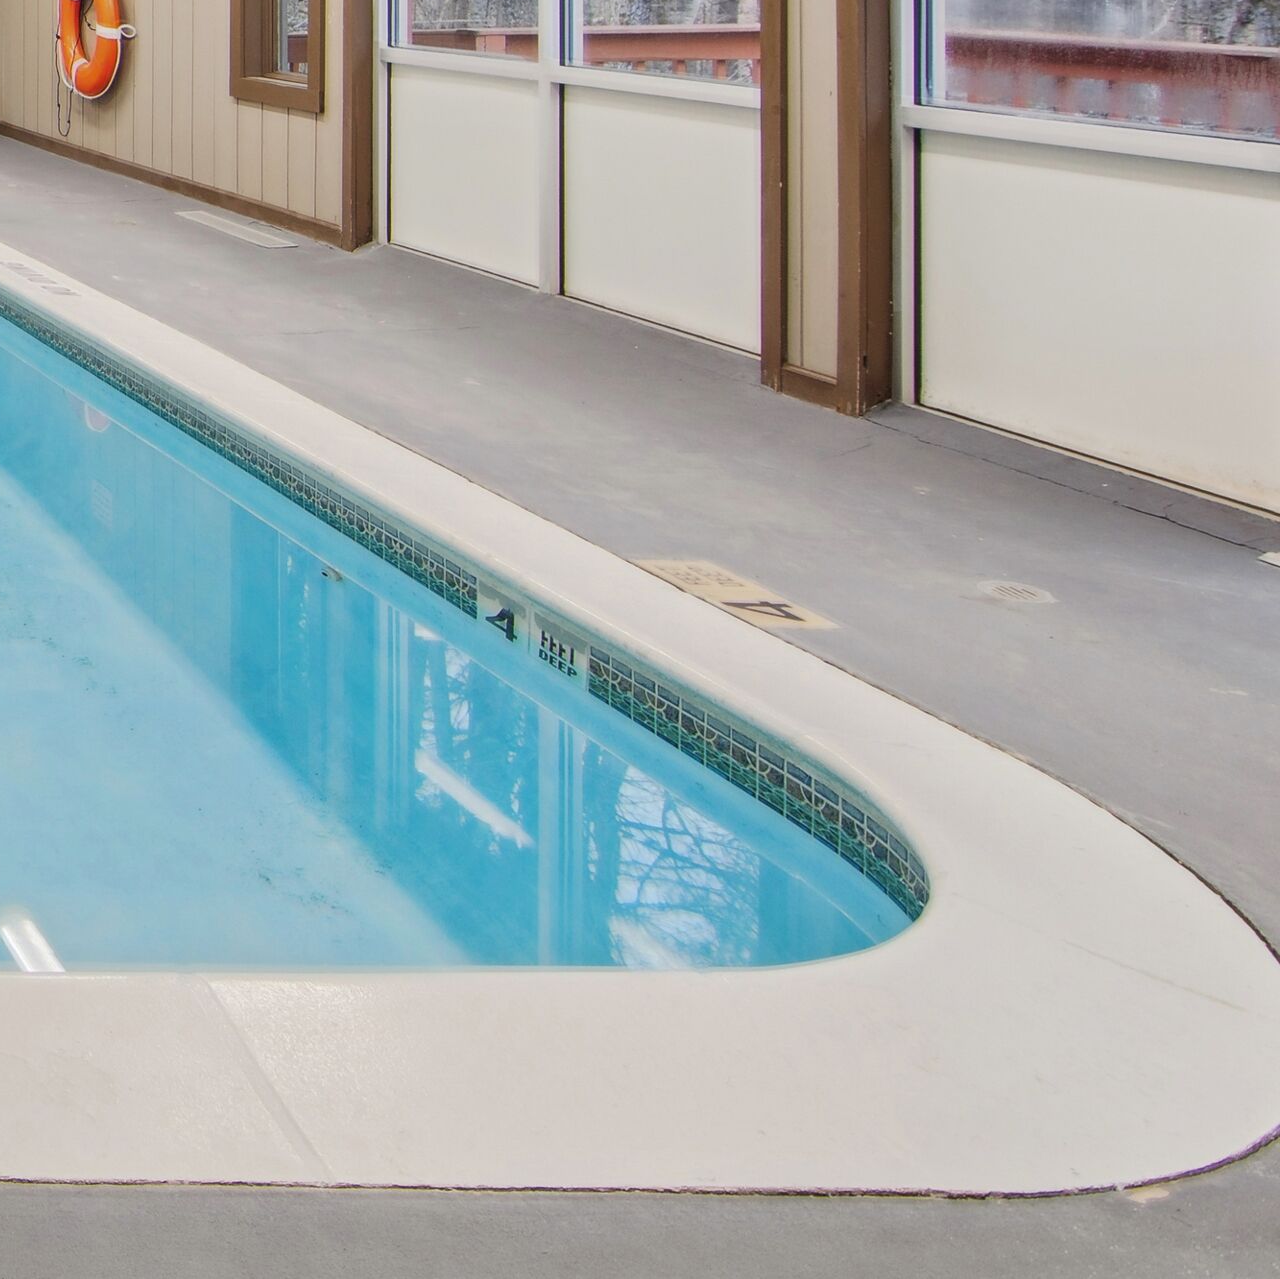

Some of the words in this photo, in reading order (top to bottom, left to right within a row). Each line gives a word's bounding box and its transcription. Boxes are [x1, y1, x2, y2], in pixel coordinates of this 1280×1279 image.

[485, 608, 517, 643] 4
[720, 601, 807, 622] 4
[538, 648, 577, 677] DEEP
